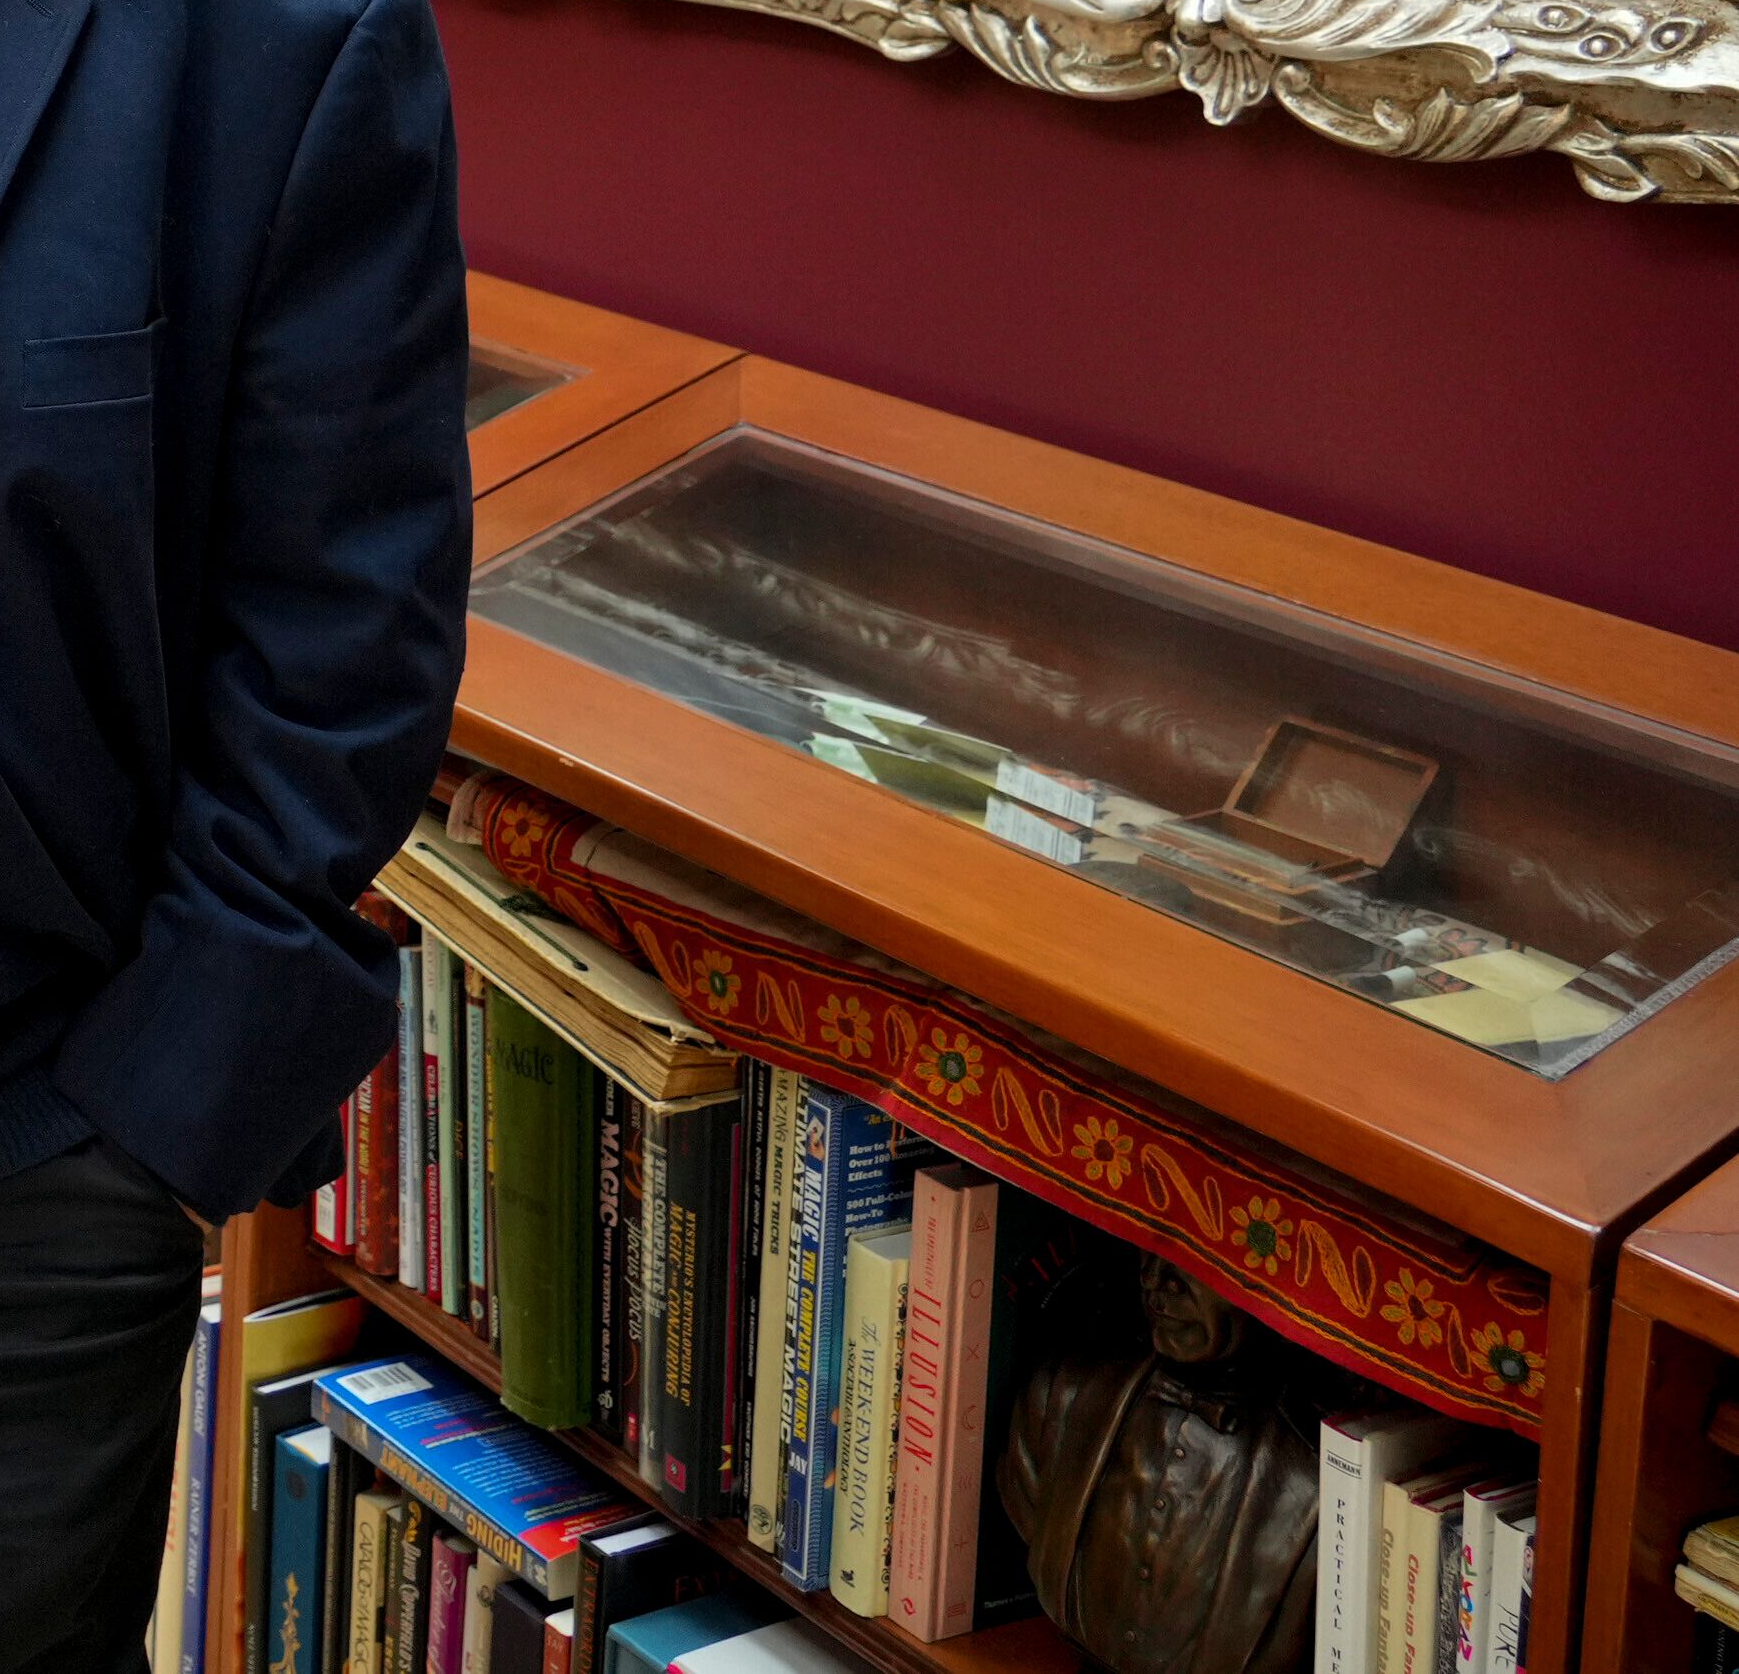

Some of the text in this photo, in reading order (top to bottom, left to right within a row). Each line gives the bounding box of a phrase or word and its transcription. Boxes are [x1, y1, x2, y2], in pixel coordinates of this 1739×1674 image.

[425, 1064, 438, 1153] CELEBRATIONS
[849, 1144, 872, 1156] How
[873, 1142, 885, 1151] to
[427, 1164, 439, 1212] CURIOUS
[653, 1158, 667, 1198] THE
[769, 1069, 791, 1255] MAZING MAGIC TRICKS
[848, 1158, 874, 1169] Over
[848, 1169, 884, 1182] Effects
[427, 1214, 440, 1292] CHARACTERS
[600, 1117, 620, 1383] MAGIC WITH EVERYDAY OBJECTS
[651, 1199, 666, 1292] COMPLETE
[669, 1202, 683, 1267] MAGIC
[680, 1210, 697, 1407] MYSTERIO'S ENCYCLOPEDIA OF
[784, 1221, 803, 1335] STREET
[793, 1167, 823, 1444] MAGIC THE COMPLETE COURSE
[194, 1329, 208, 1386] ANTONI
[665, 1287, 681, 1398] CONJURING
[901, 1286, 942, 1468] ILLUSION
[779, 1341, 796, 1446] MAGIC
[850, 1317, 881, 1538] The WEEK-END BOOK
[380, 1441, 448, 1511] ELEPHANT
[788, 1451, 808, 1476] JAY
[1326, 1454, 1362, 1476] ANNEMANN
[188, 1476, 201, 1535] RAINER
[466, 1512, 523, 1572] HIDING
[1332, 1498, 1346, 1630] PRACTICAL
[1378, 1527, 1394, 1610] Close-up
[1403, 1552, 1420, 1635] Close-up
